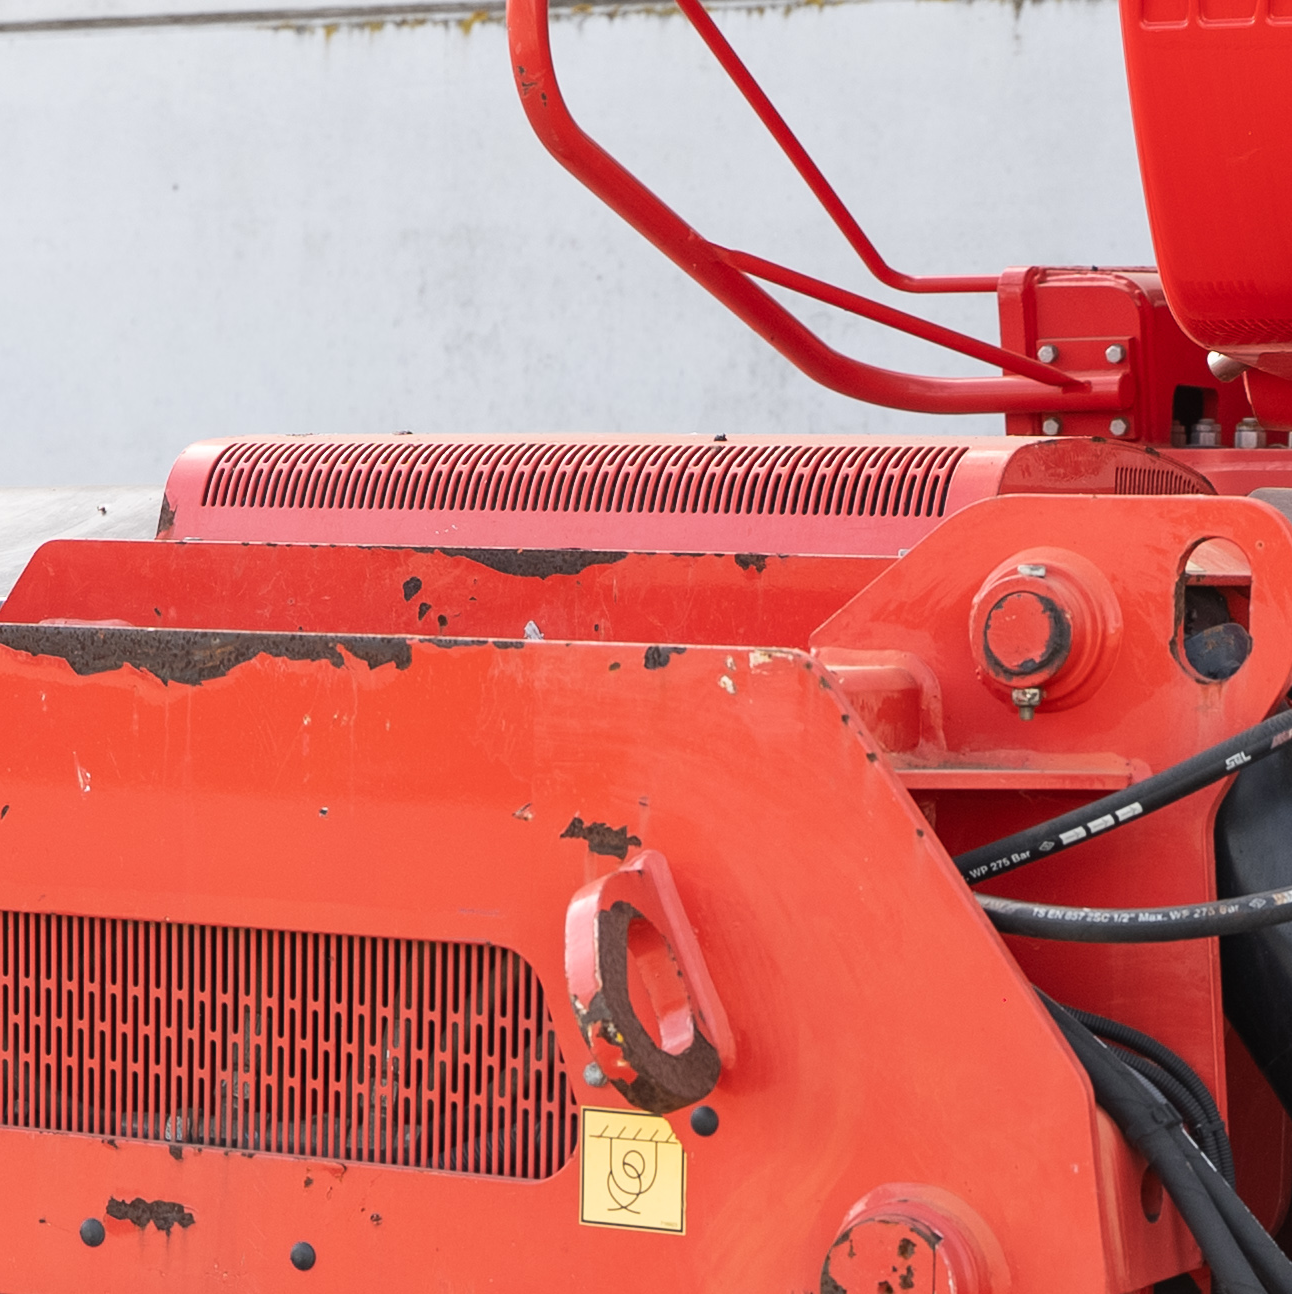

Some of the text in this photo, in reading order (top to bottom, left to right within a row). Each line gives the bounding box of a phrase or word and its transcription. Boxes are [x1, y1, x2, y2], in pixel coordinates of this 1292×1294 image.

[969, 865, 989, 879] WP
[990, 857, 1010, 871] 275
[1011, 850, 1031, 863] Bar
[1047, 908, 1063, 920] EN
[1138, 912, 1168, 923] Max.
